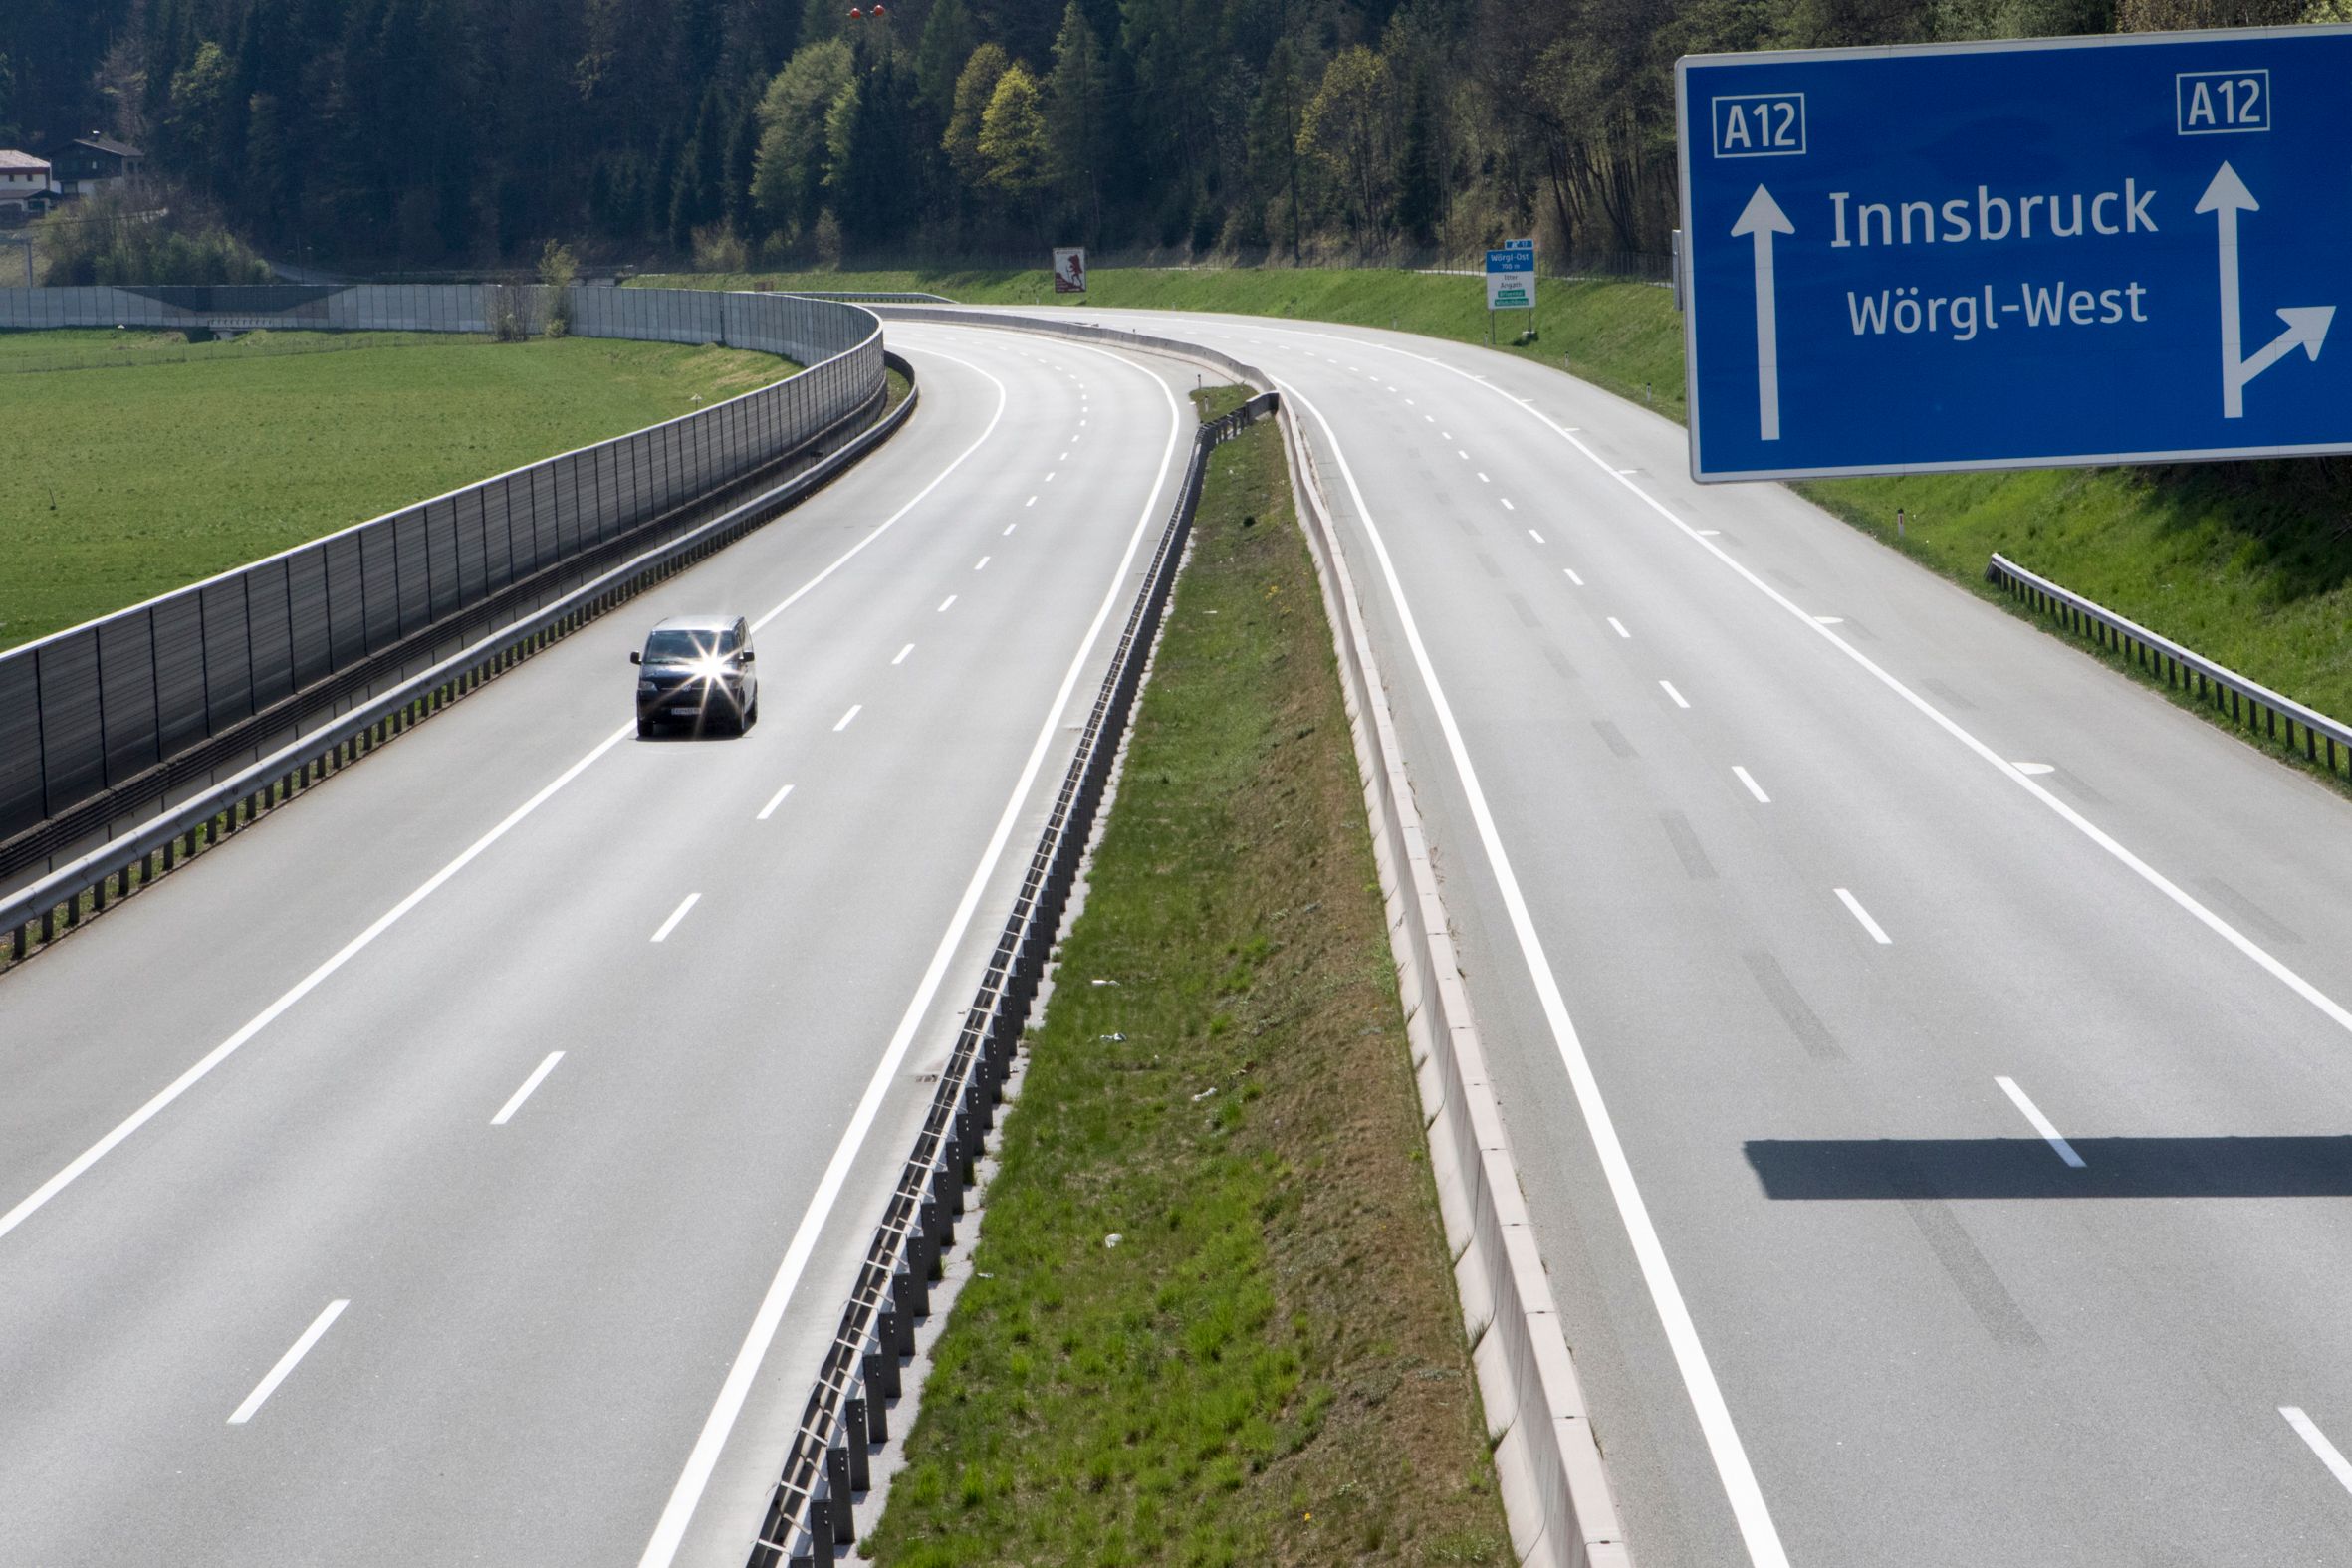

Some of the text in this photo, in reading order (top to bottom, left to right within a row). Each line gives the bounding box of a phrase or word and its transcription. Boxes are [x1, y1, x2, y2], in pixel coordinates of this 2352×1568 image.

[1725, 102, 1795, 148] A12
[2189, 80, 2260, 125] A12
[1830, 178, 2158, 248] Innsbruck
[1847, 282, 2148, 341] Wörgl-West
